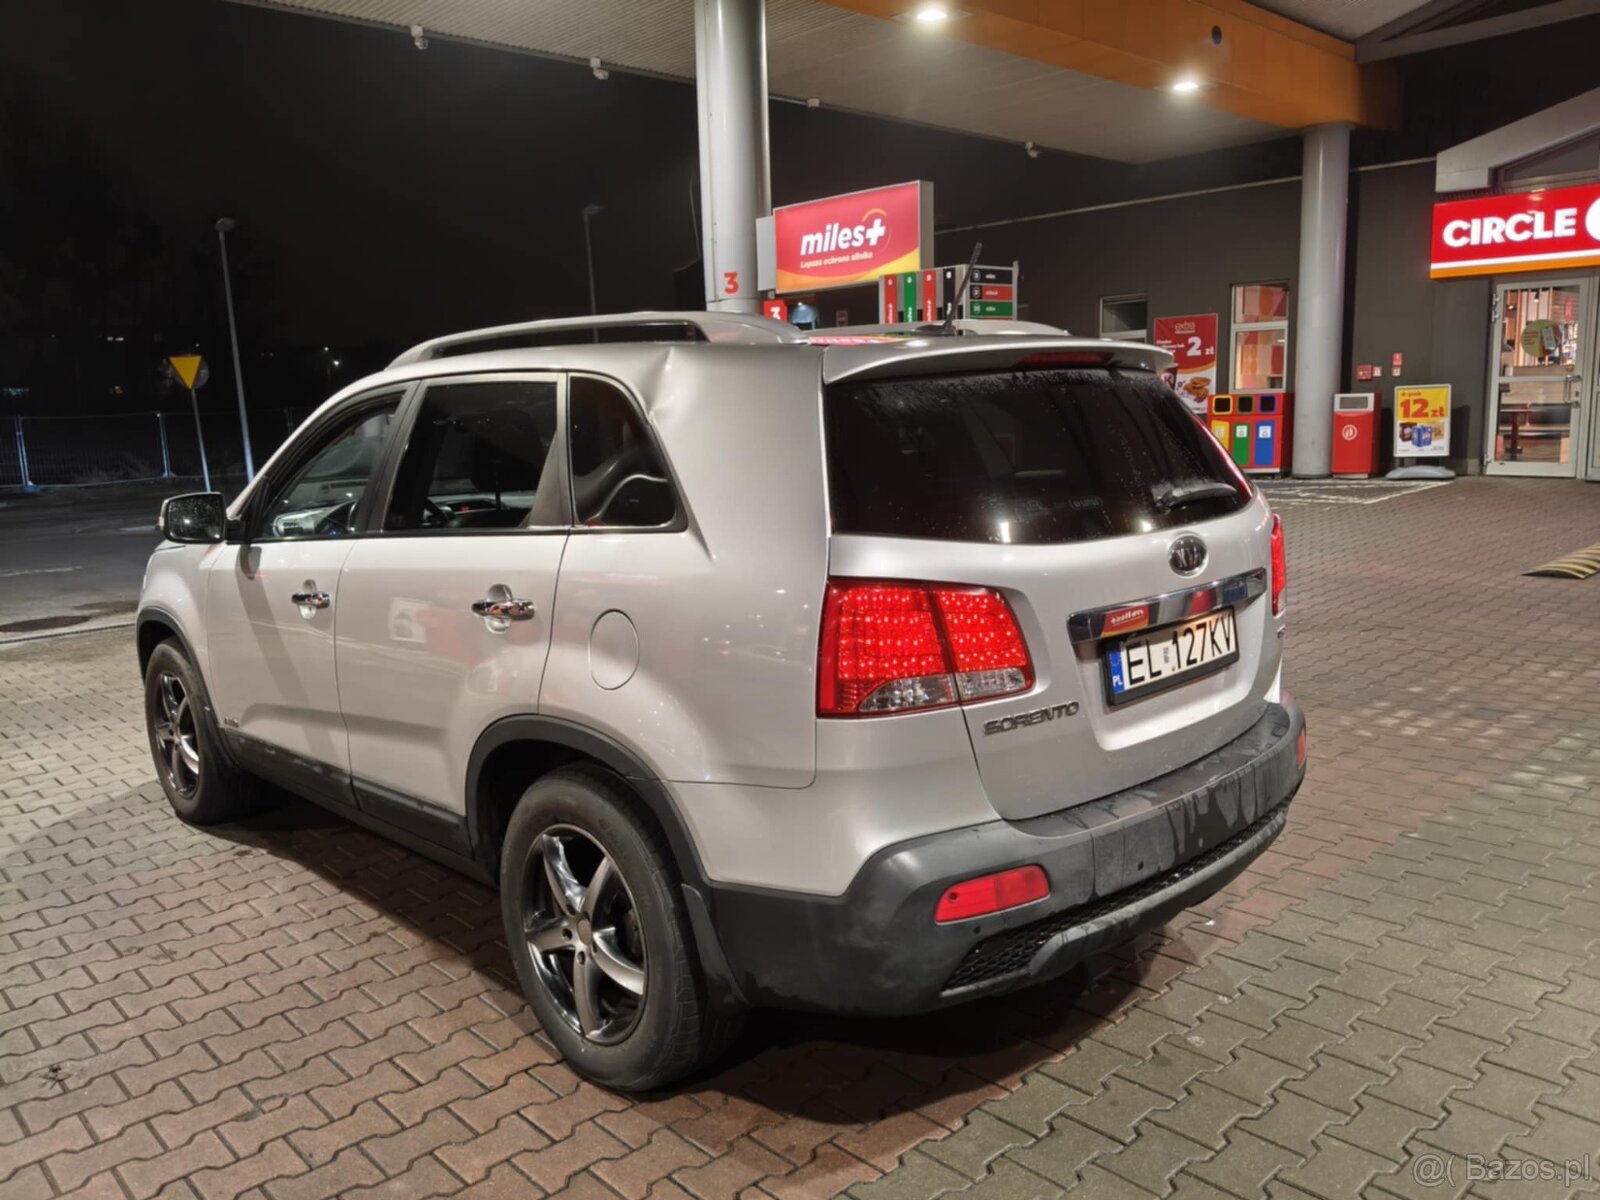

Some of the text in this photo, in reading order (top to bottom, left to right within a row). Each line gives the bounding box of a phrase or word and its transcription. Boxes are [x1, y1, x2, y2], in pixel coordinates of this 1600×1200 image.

[800, 218, 886, 255] miles+
[1443, 208, 1577, 248] CIRCLE
[724, 272, 739, 294] 3
[1186, 336, 1202, 356] 2
[1400, 398, 1429, 418] 12
[1125, 611, 1234, 685] EL 127KV
[984, 701, 1079, 736] SORENTO
